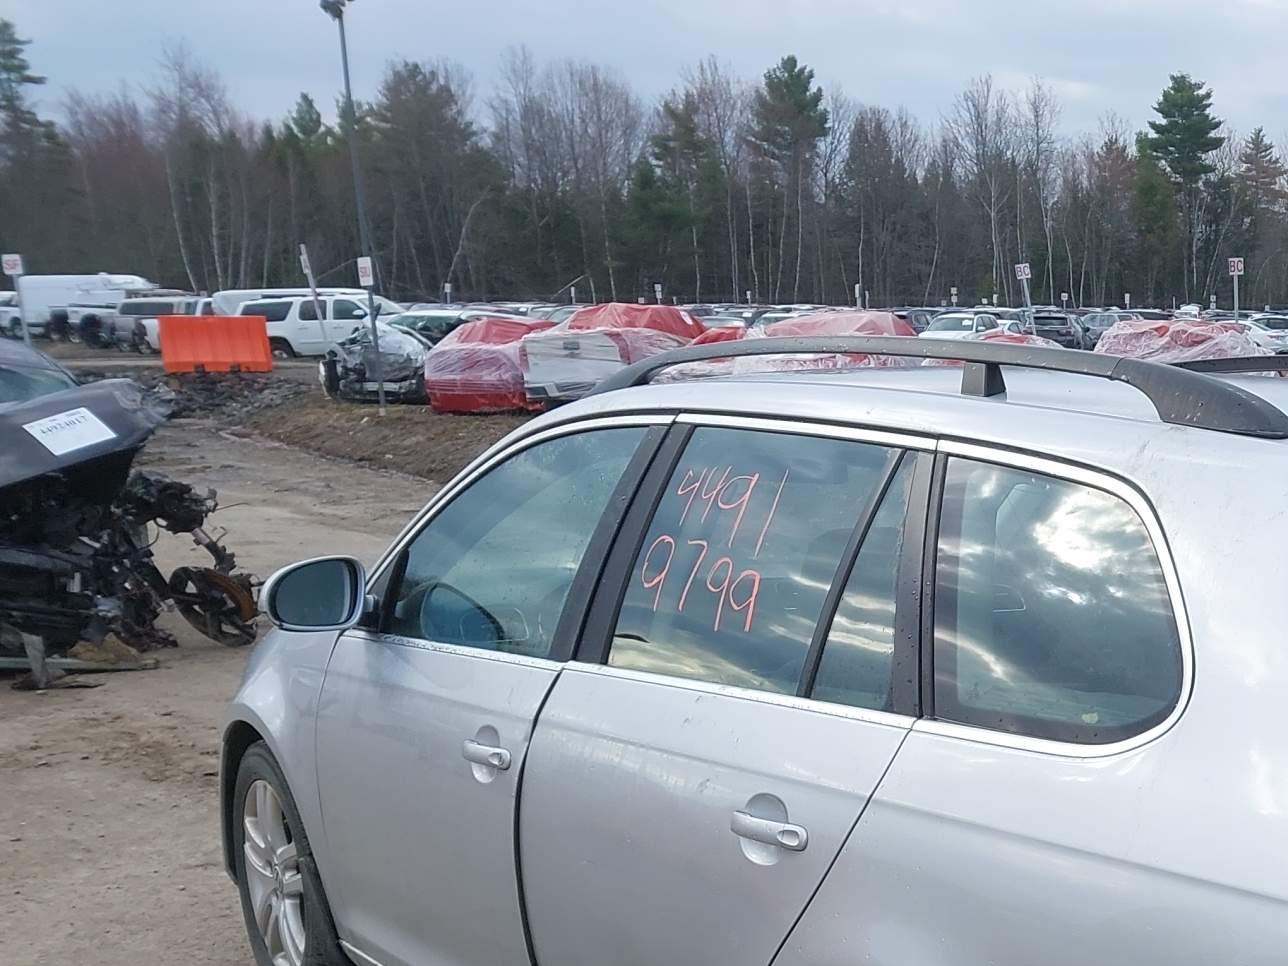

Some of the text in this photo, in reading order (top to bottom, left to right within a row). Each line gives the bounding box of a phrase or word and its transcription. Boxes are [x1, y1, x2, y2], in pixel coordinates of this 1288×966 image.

[1015, 265, 1030, 278] BC
[1229, 259, 1243, 273] BC
[677, 465, 789, 560] 4491
[641, 535, 760, 632] 9799
